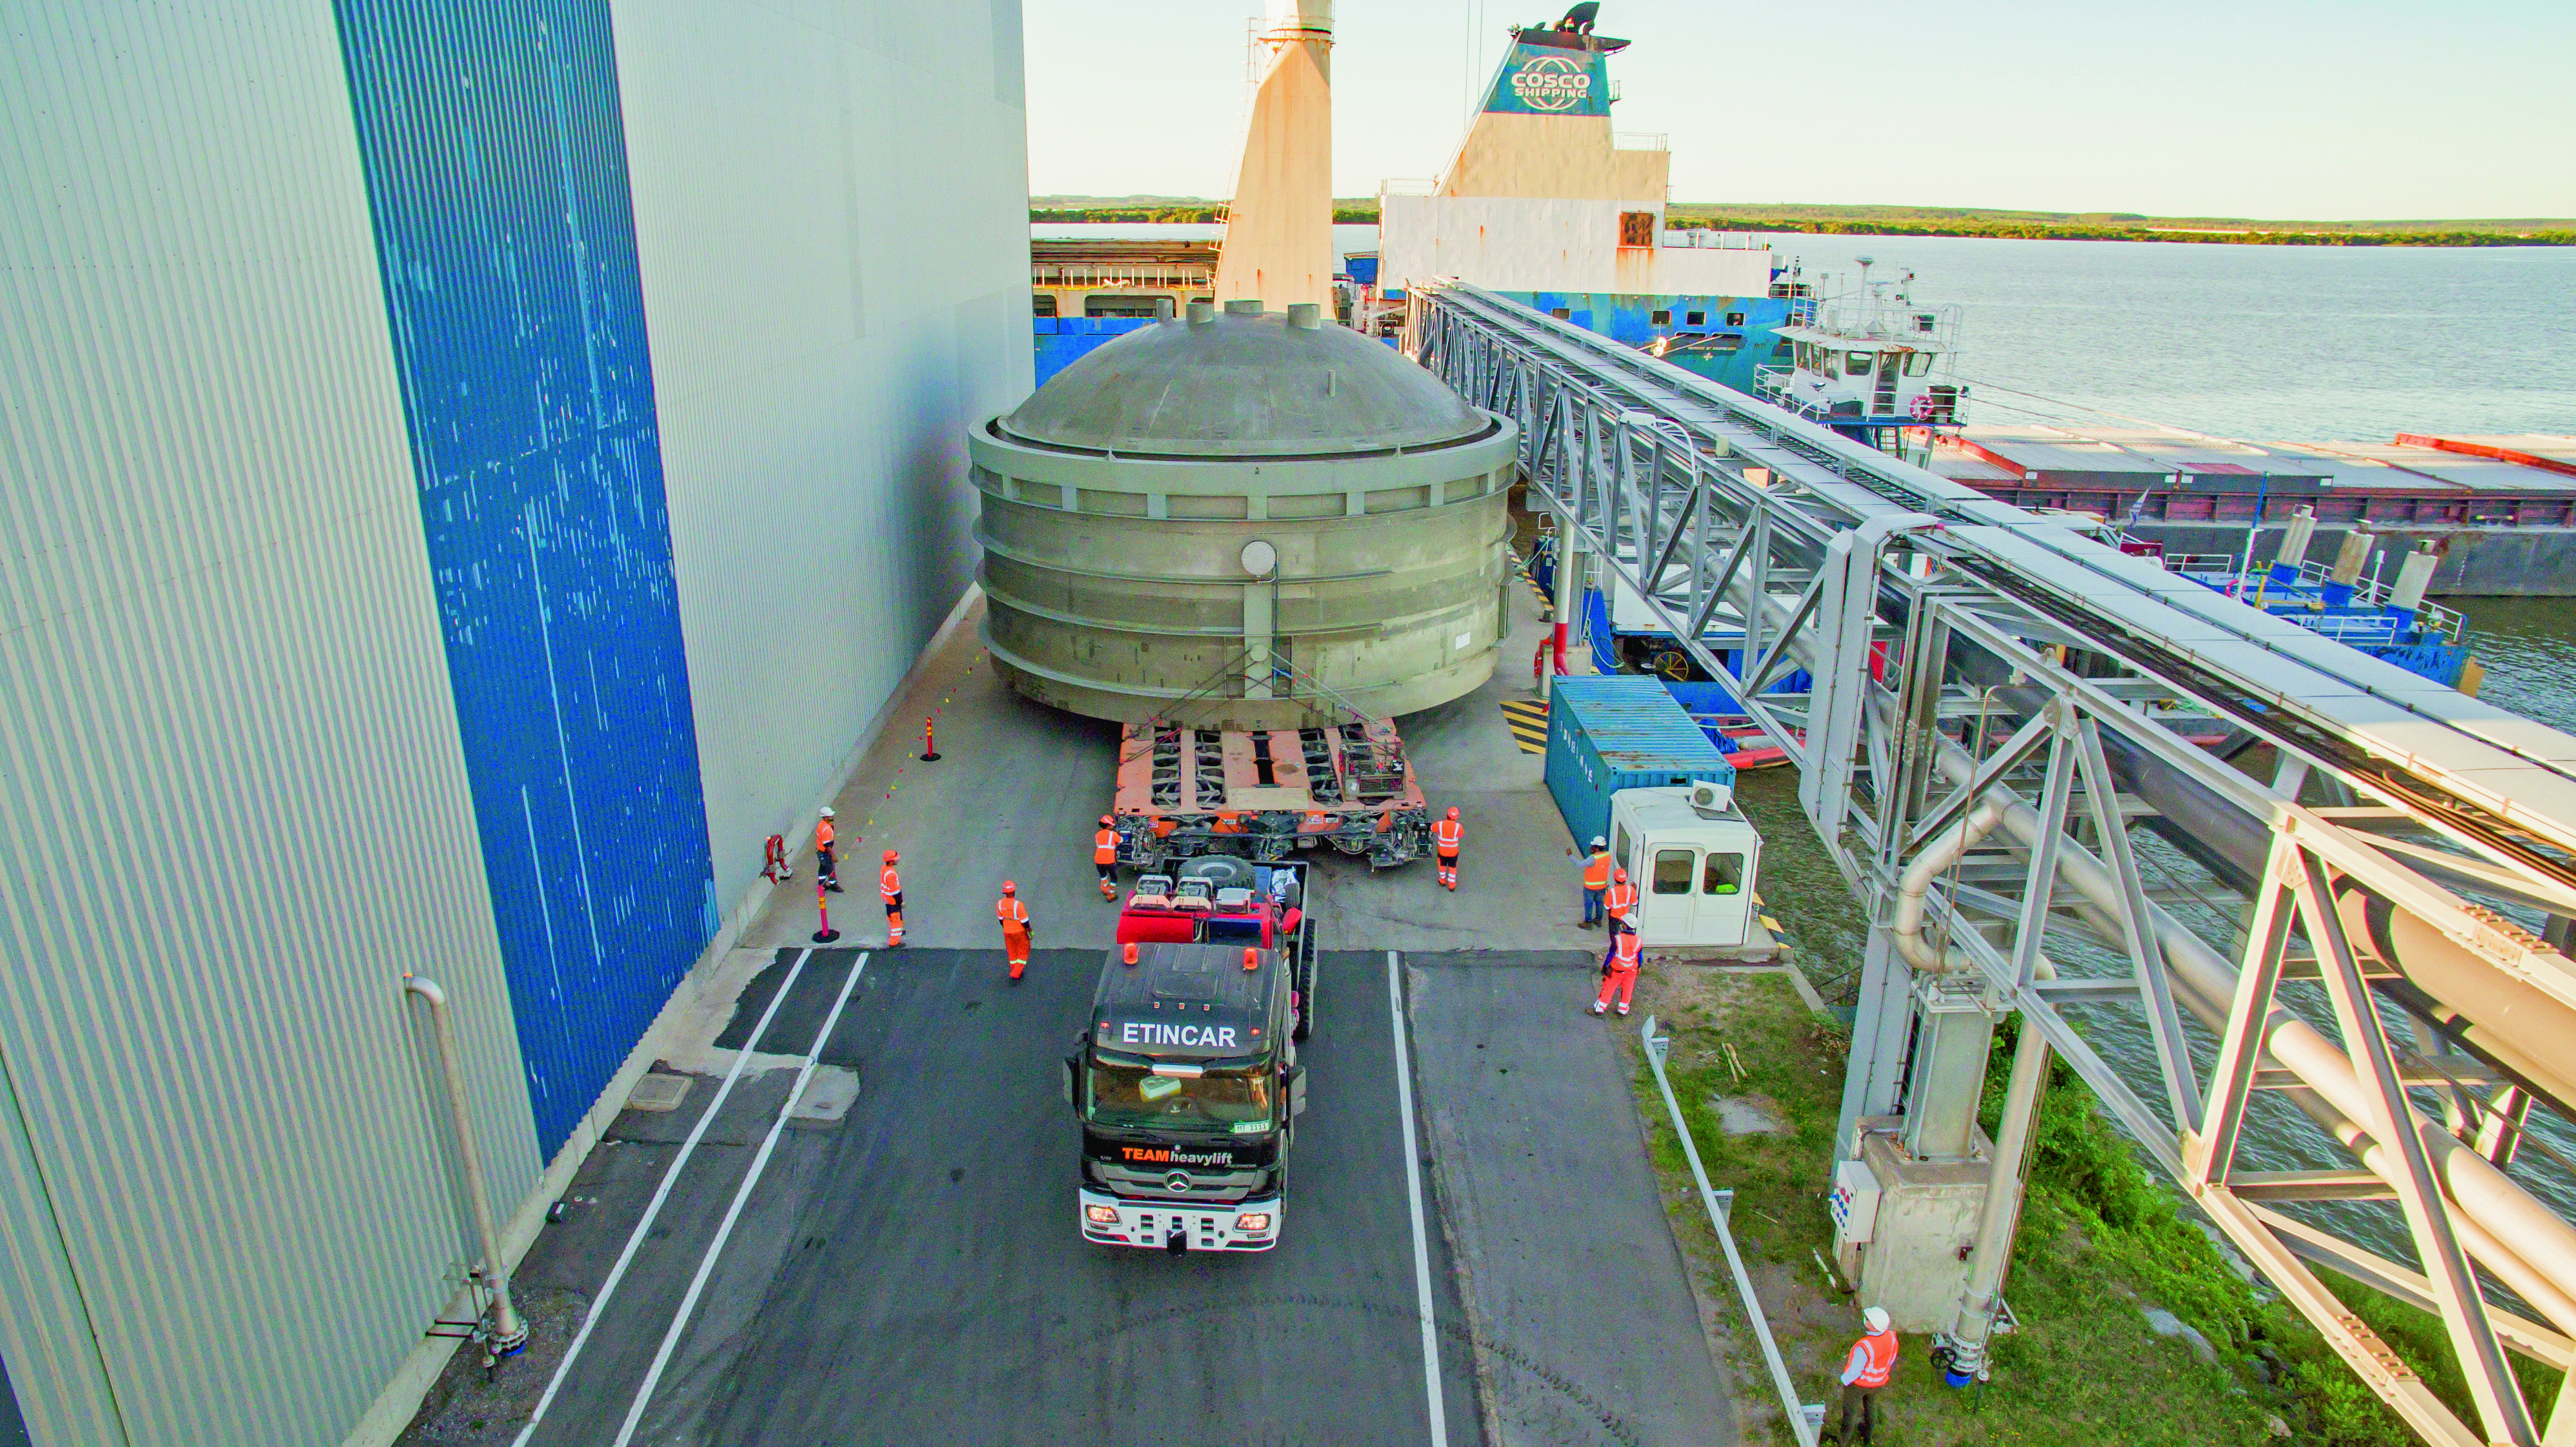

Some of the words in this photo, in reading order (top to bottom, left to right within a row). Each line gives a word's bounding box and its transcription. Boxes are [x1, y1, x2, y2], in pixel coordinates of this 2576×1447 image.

[1511, 72, 1591, 88] COSCO
[1514, 87, 1587, 98] SHIPPING
[1123, 1022, 1236, 1047] ETINCAR
[1122, 1147, 1233, 1166] TEAMheavylift
